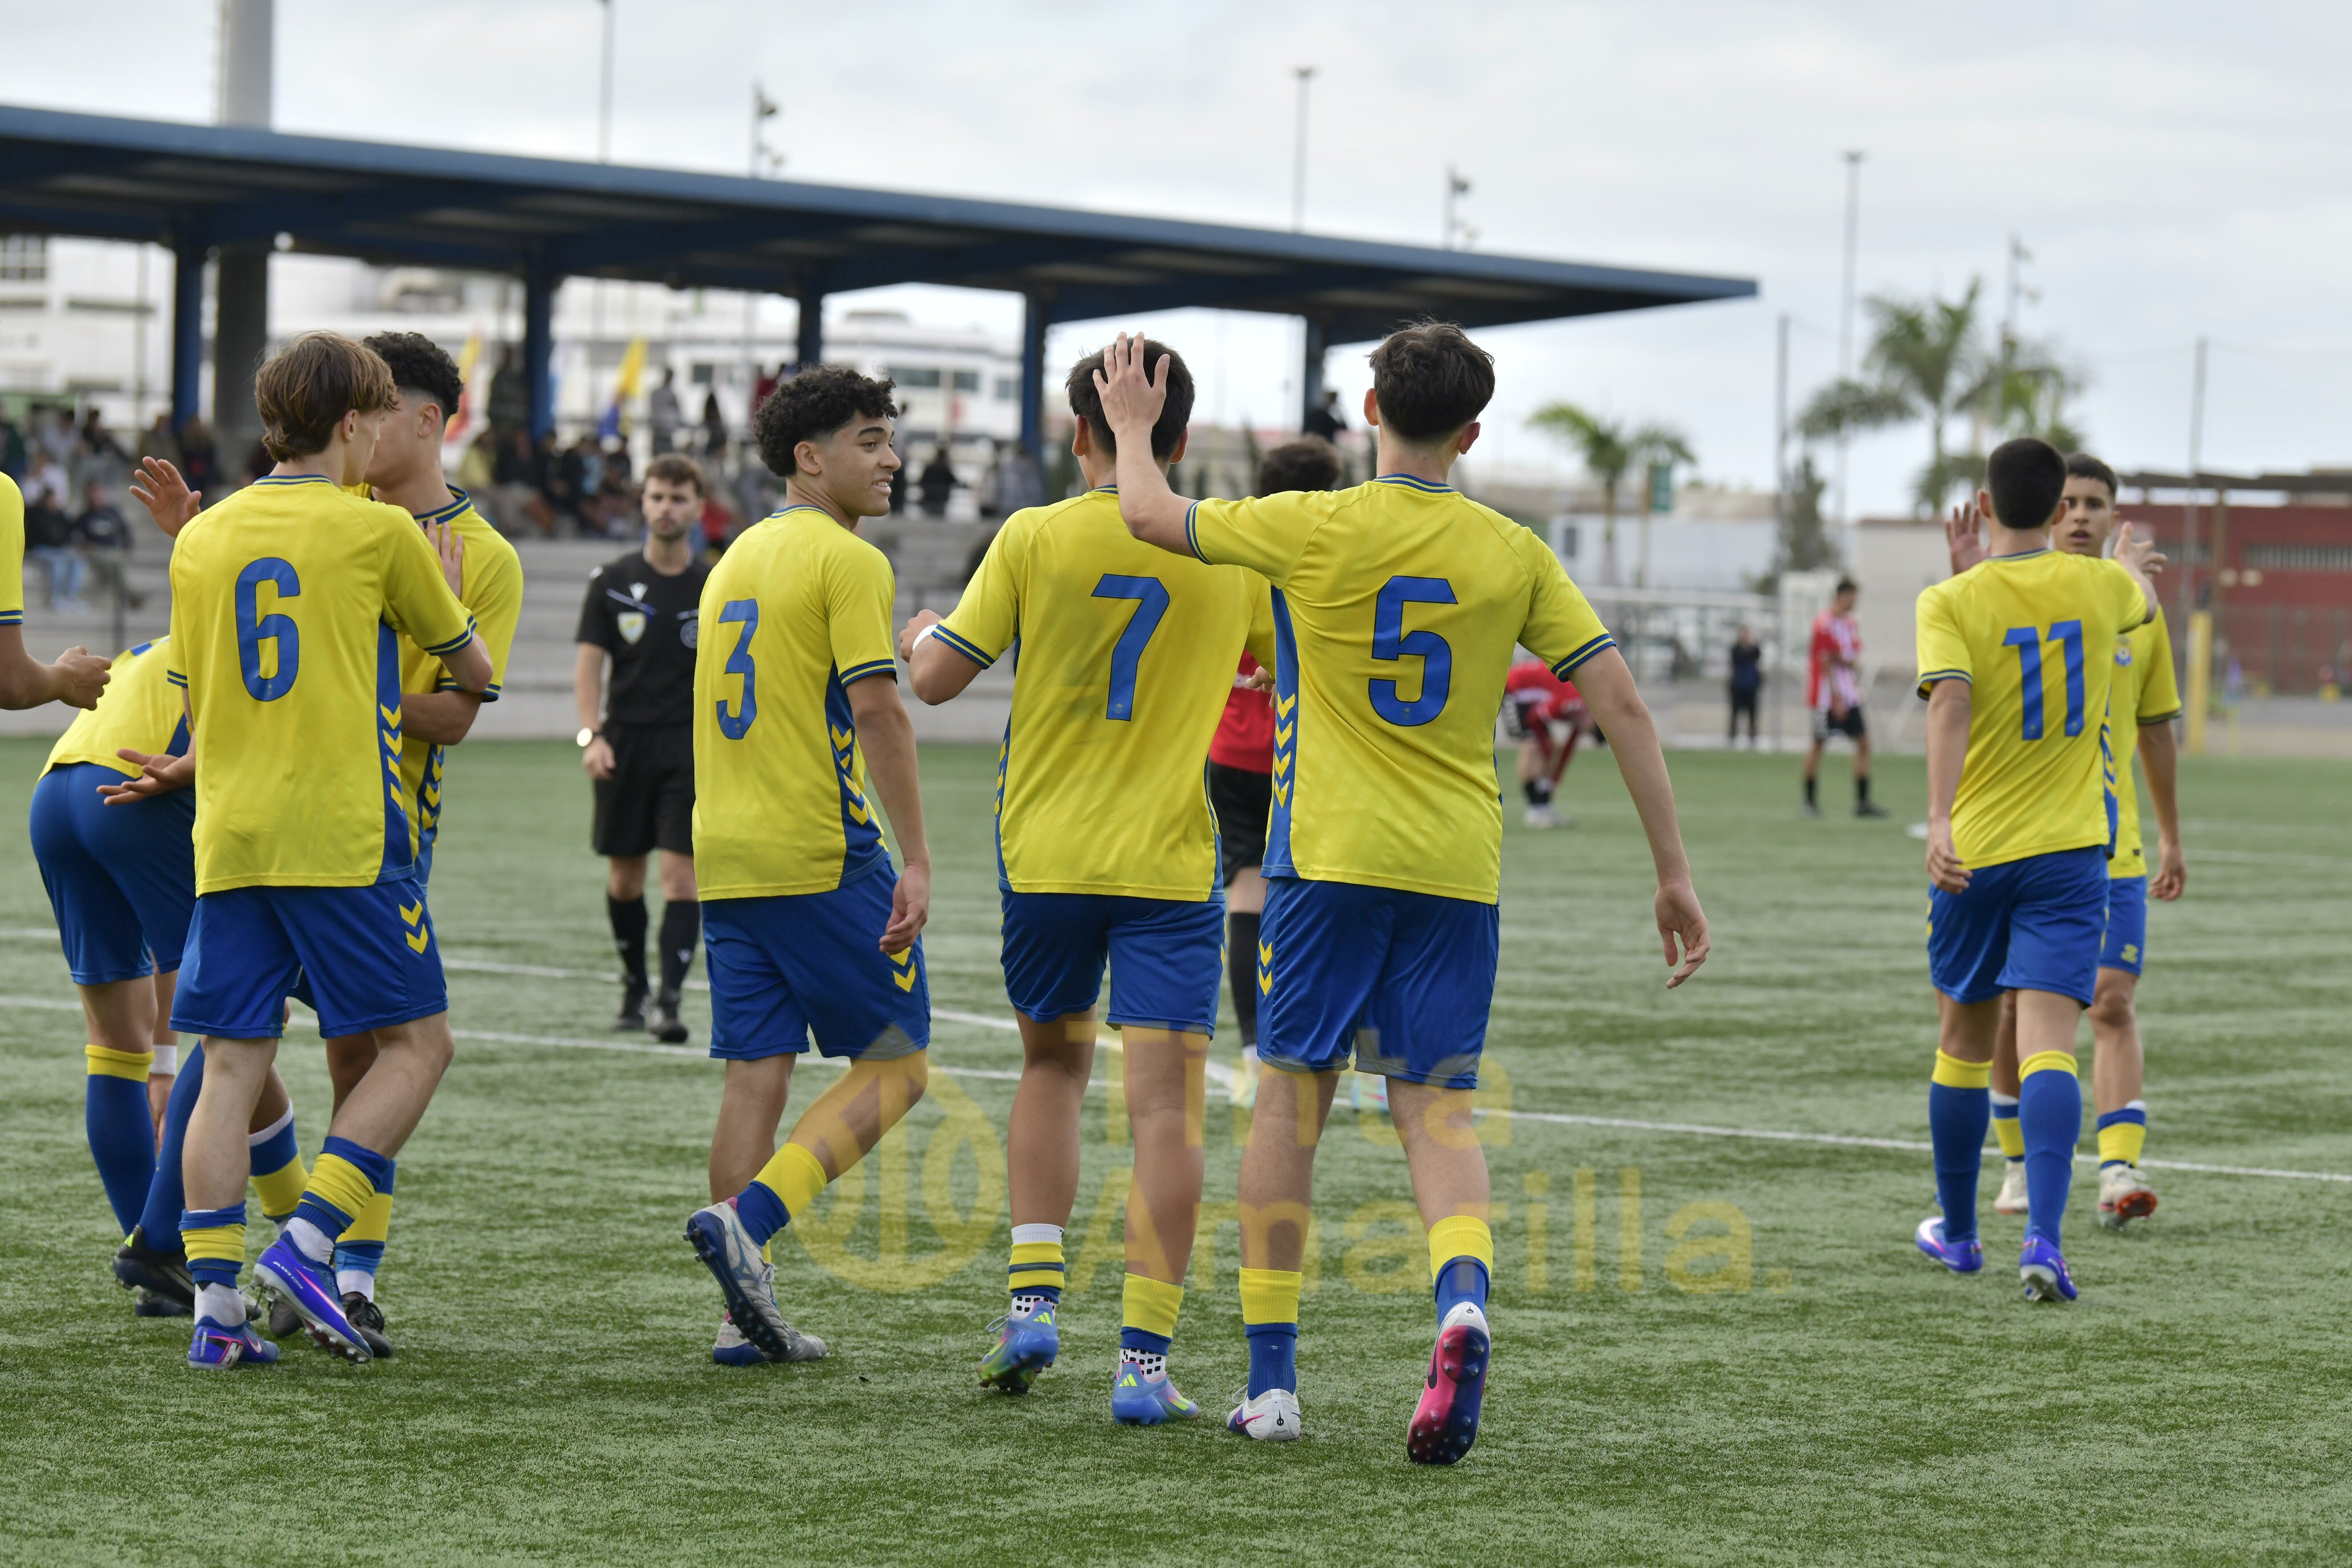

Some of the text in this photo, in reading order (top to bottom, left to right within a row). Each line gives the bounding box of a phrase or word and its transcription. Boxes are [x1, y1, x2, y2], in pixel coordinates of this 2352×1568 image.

[235, 557, 300, 702] 6
[716, 598, 758, 740] 3
[1091, 573, 1170, 721] 7
[1369, 575, 1459, 726] 5
[2002, 619, 2085, 741] 11
